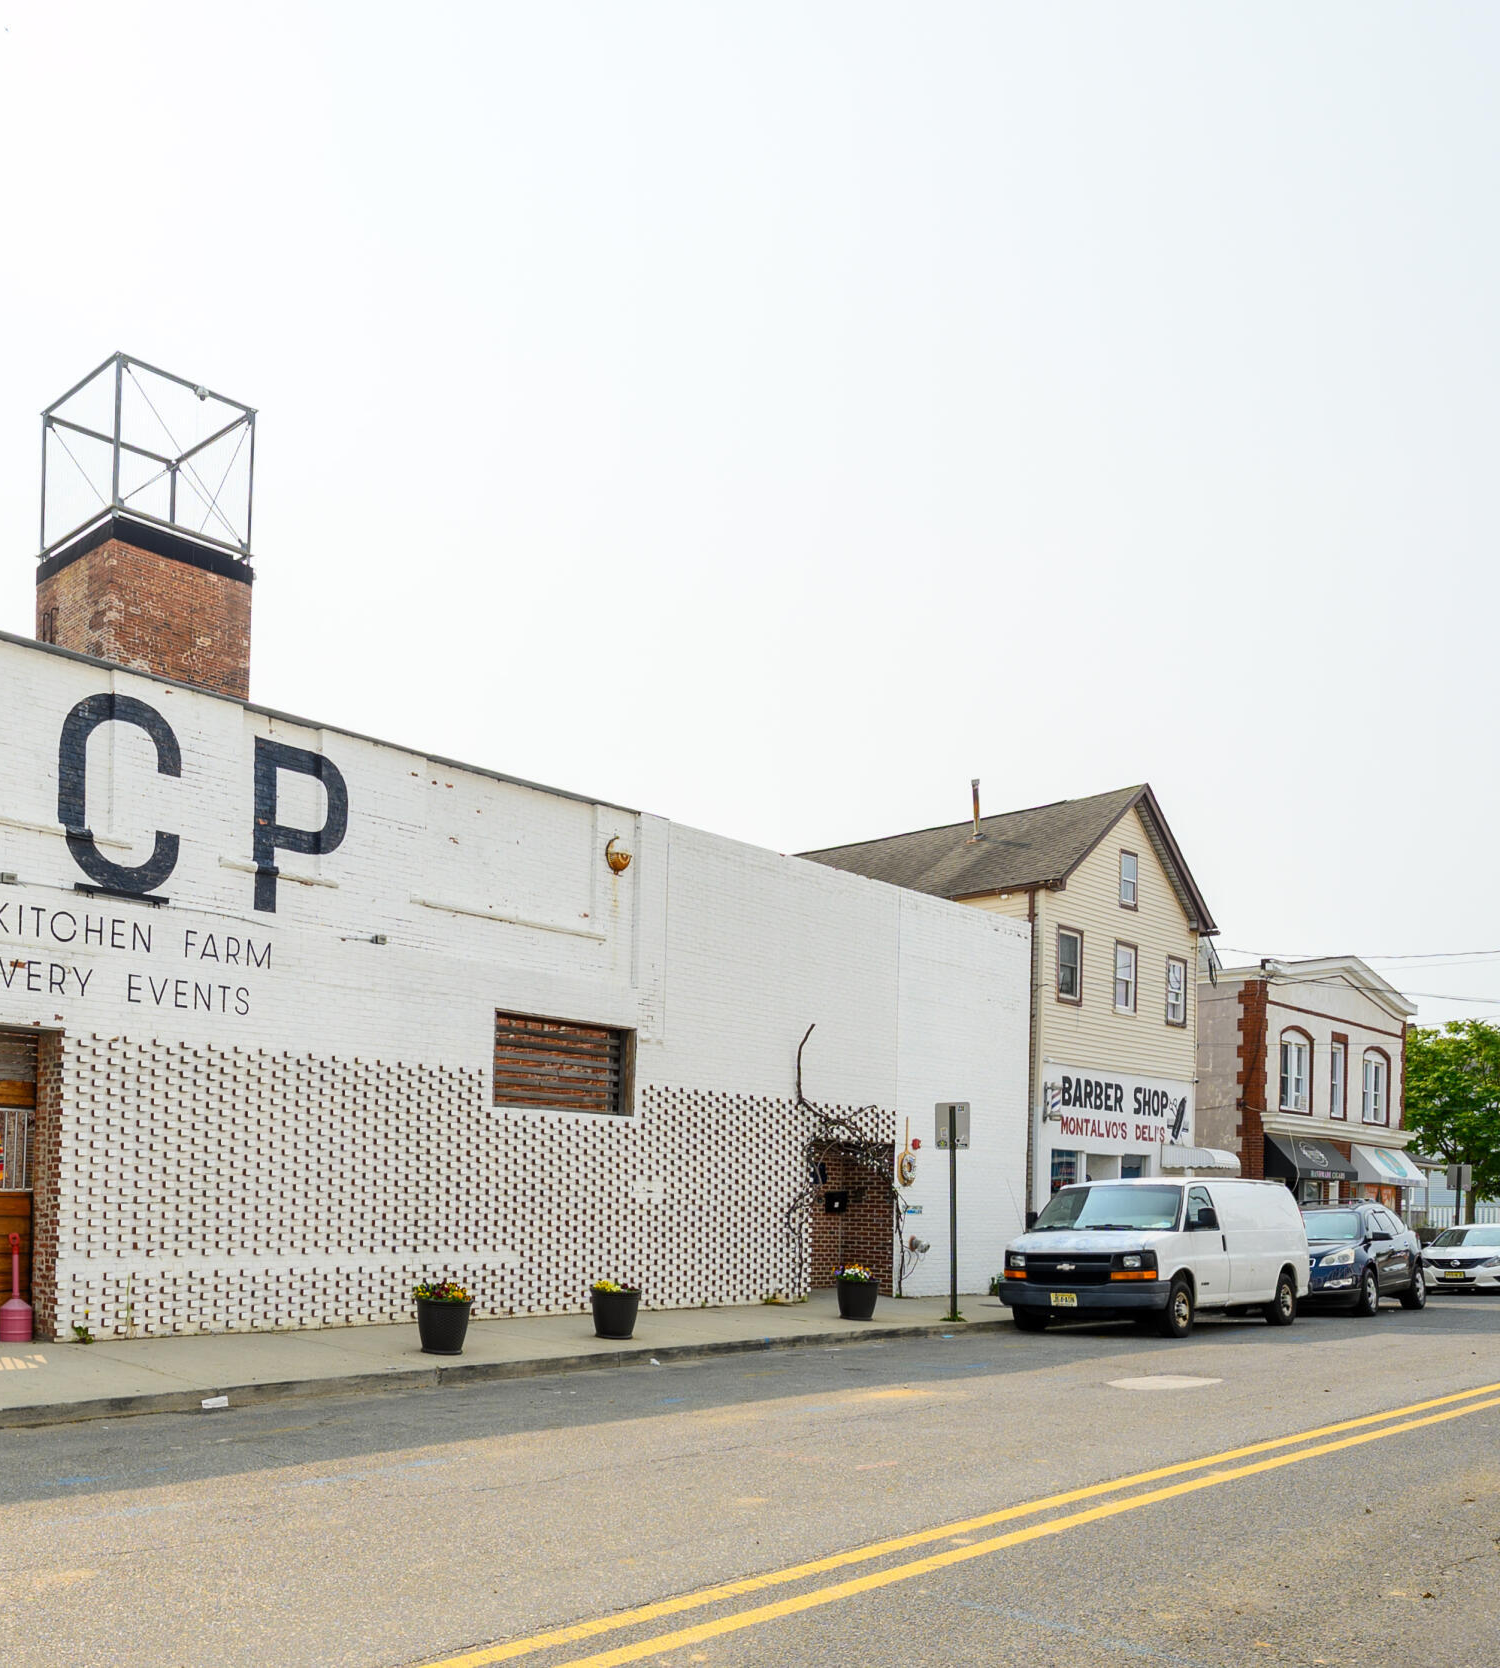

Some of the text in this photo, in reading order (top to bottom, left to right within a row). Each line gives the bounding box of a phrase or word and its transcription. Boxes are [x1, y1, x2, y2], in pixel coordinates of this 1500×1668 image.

[183, 929, 273, 970] FARM
[126, 973, 251, 1016] EVENTS
[1061, 1075, 1169, 1118] BARBER SHOP
[1060, 1115, 1128, 1141] MONTALVO'S
